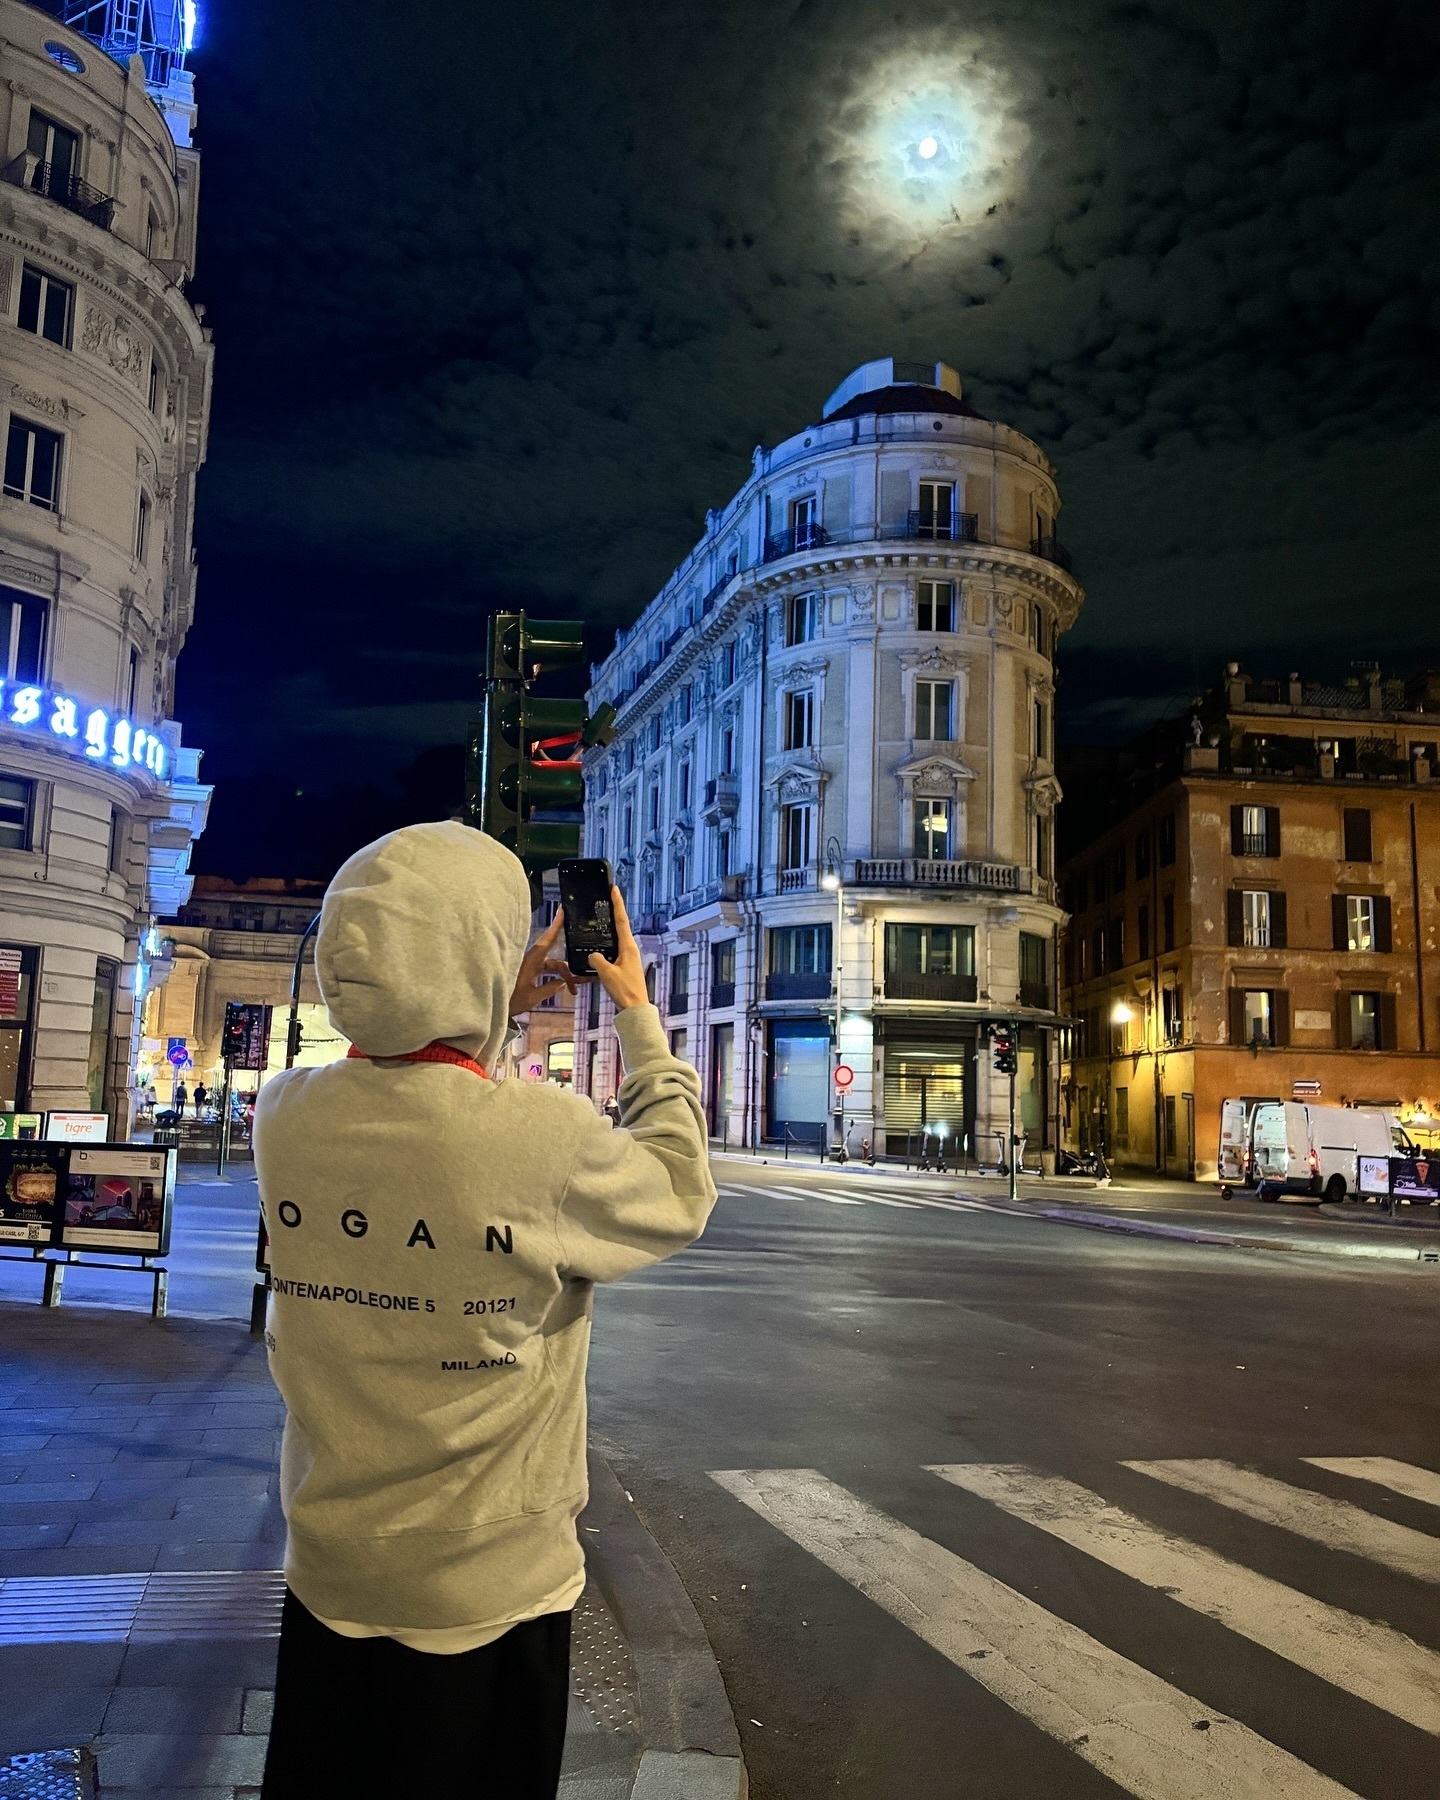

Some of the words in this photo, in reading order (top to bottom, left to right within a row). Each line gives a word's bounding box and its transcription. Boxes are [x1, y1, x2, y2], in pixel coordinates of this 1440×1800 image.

[65, 1122, 92, 1136] tigre
[260, 1200, 514, 1254] OGAN
[271, 1277, 420, 1311] ONTENAPOLEONE
[425, 1299, 436, 1313] 5
[463, 1297, 516, 1315] 20121
